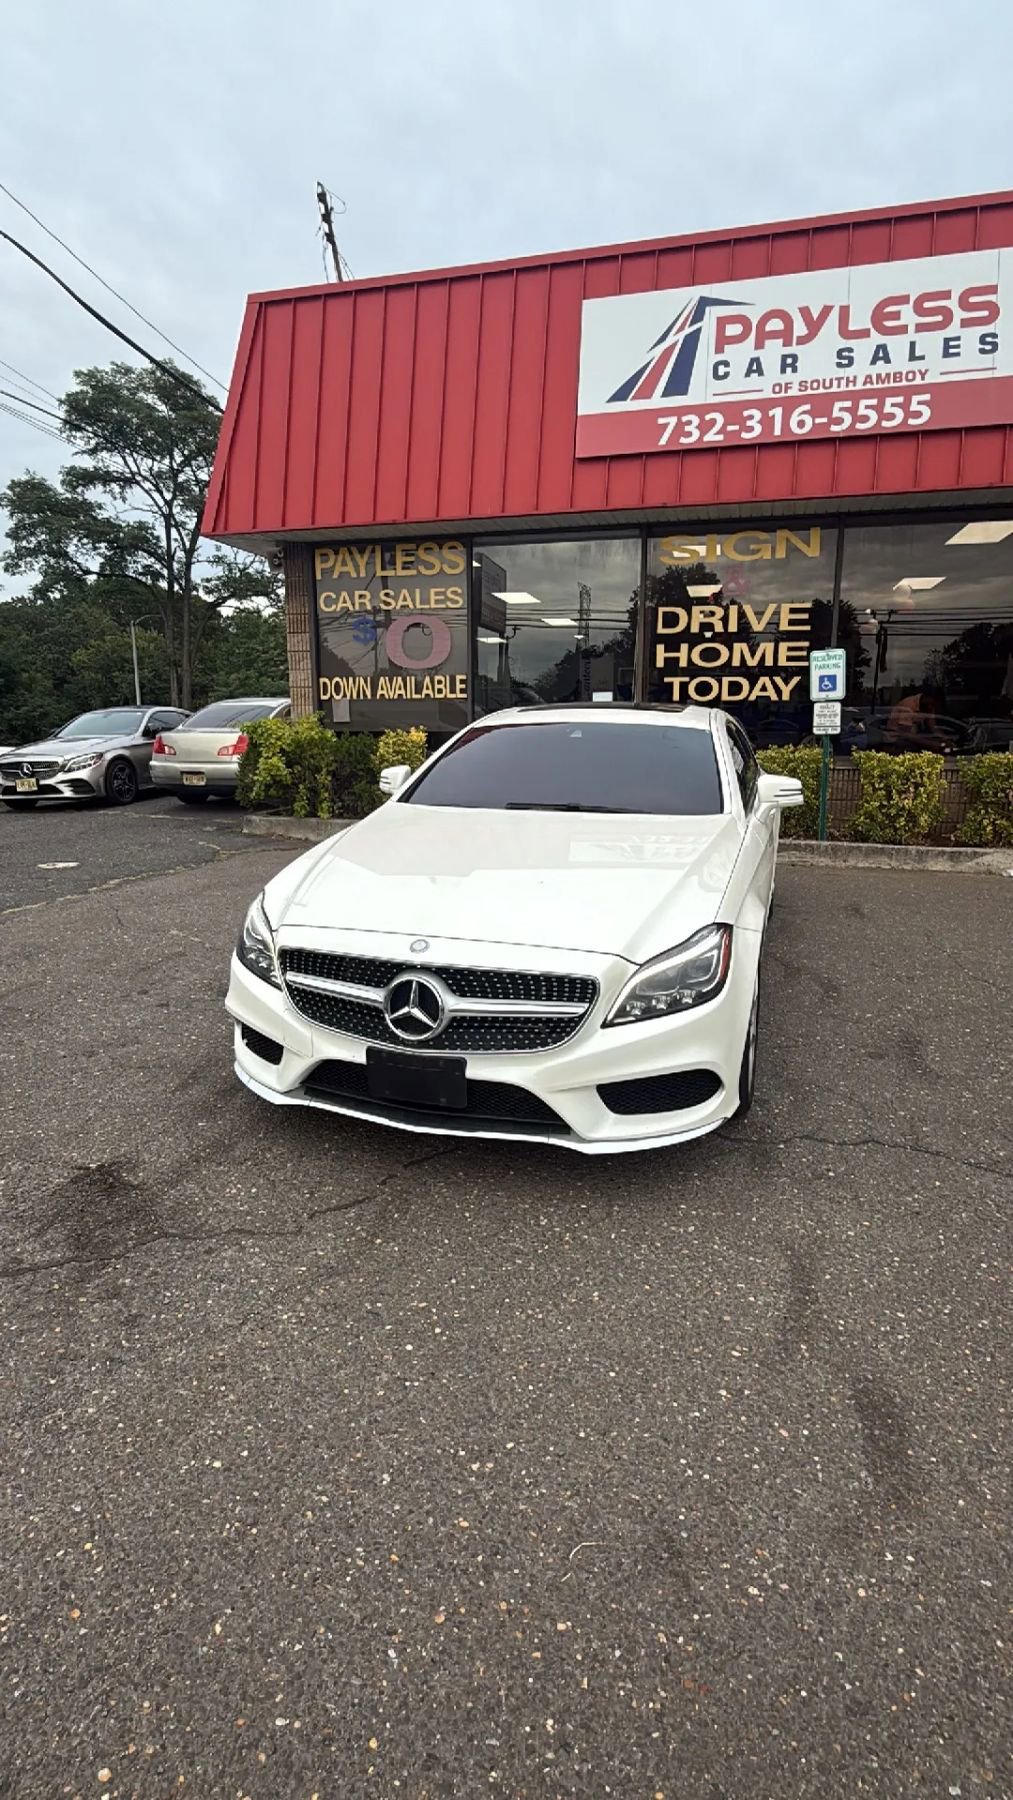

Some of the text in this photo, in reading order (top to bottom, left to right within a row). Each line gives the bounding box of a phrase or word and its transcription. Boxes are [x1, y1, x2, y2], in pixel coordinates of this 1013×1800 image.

[714, 284, 1001, 355] PAYLESS
[712, 332, 1000, 381] CAR SALES
[771, 368, 930, 395] OF SOUTH AMBOY
[657, 393, 932, 446] 732-316-5555
[313, 541, 466, 581] PAYLESS
[659, 526, 821, 565] SIGN
[319, 586, 464, 613] CAR SALES
[656, 602, 812, 635] DRIVE
[655, 641, 810, 669] HOME
[319, 673, 468, 700] DOWN AVAILABLE
[663, 675, 802, 702] TODAY
